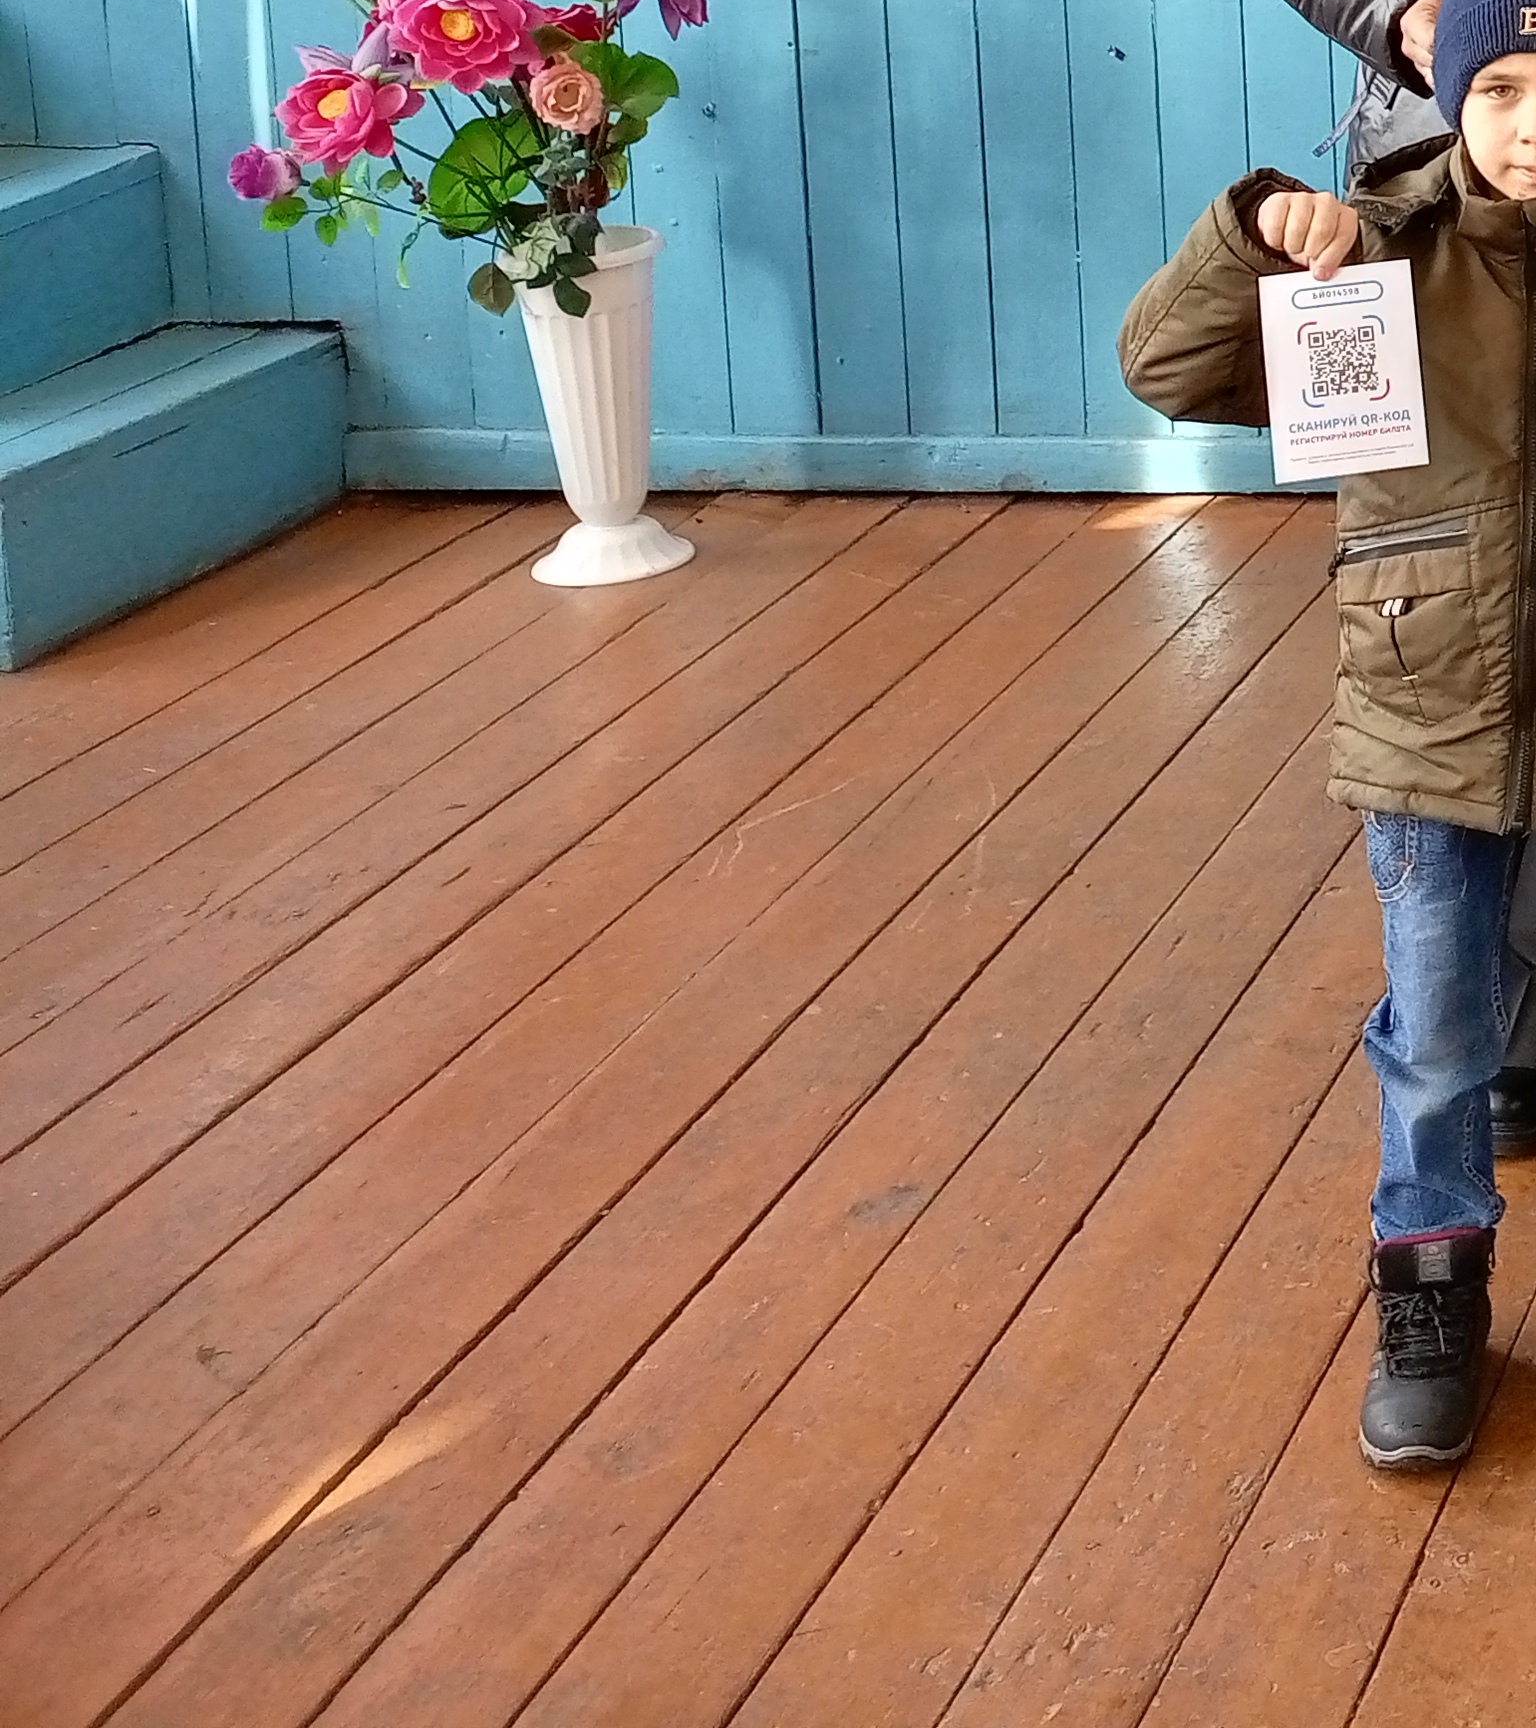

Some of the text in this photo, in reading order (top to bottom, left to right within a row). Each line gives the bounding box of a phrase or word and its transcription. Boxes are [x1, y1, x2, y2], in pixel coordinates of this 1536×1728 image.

[1288, 409, 1411, 434] СКАНИРУЙ QR-КОД
[1290, 424, 1412, 446] РЕГИСТРИРУЙ НОМЕР БИЛЕТА
